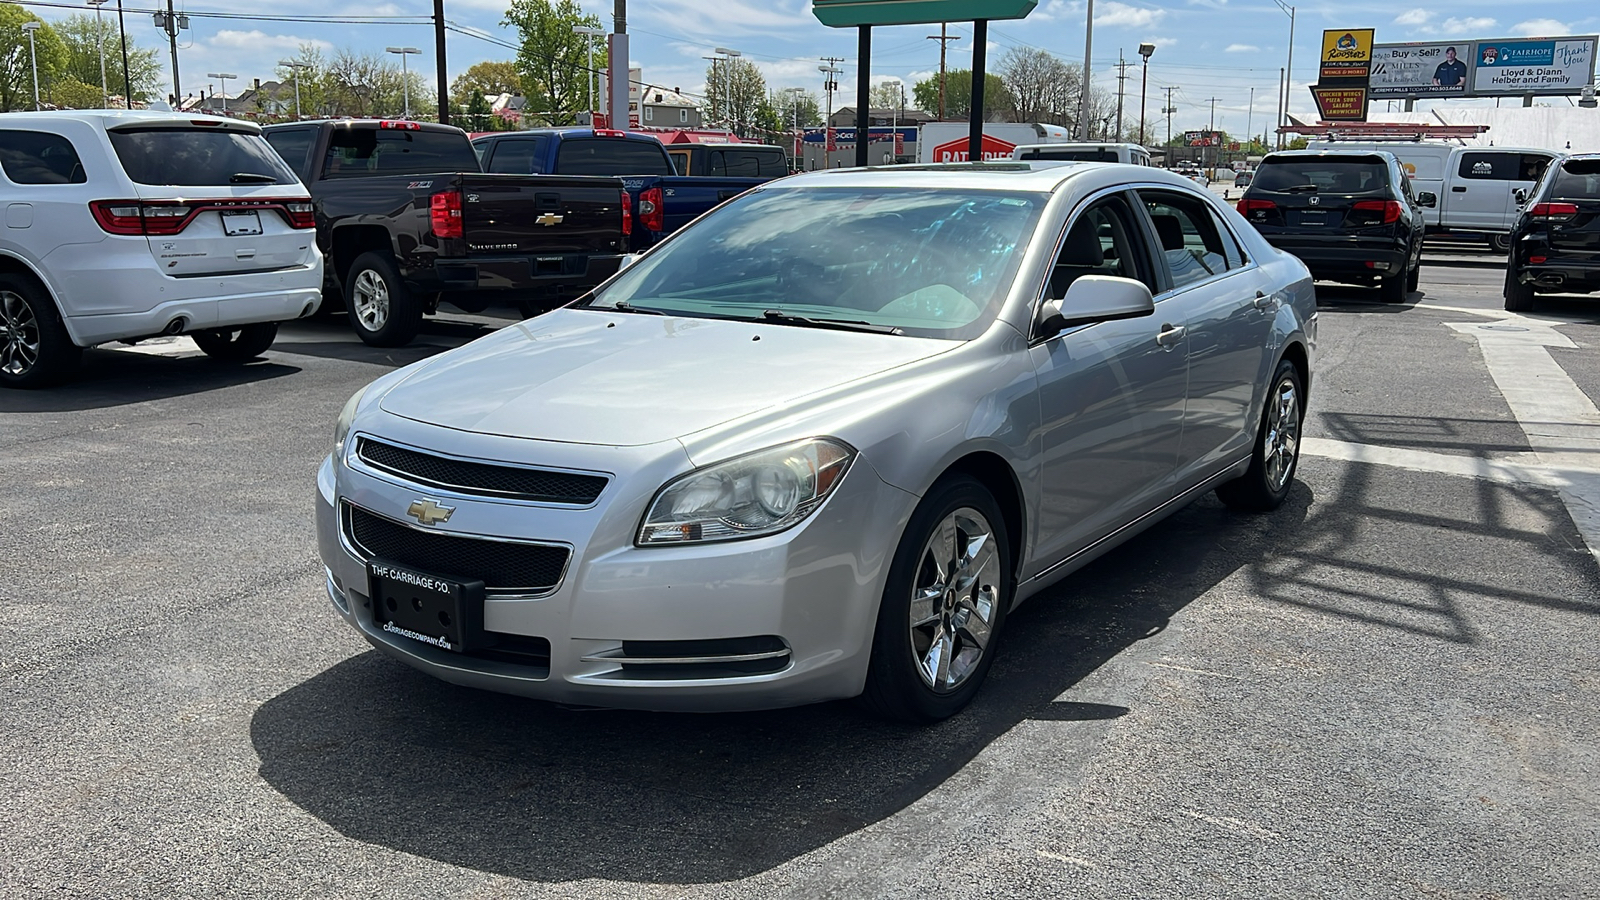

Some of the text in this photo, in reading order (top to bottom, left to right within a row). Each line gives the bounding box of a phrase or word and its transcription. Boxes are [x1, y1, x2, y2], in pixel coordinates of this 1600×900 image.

[1327, 48, 1365, 60] Roosters
[1392, 50, 1409, 59] Buy
[1418, 48, 1440, 57] Sell?
[1512, 48, 1552, 56] FAIRHOPE
[1556, 42, 1589, 59] Thank
[1392, 62, 1420, 70] MILLS
[1563, 56, 1584, 69] You
[1501, 68, 1525, 77] Lloyd
[1491, 76, 1520, 84] Helber
[1541, 75, 1571, 84] Family
[371, 564, 451, 594] THE CARRIAGE CO.
[383, 623, 452, 650] CARRIAGECOMPANY.COM
